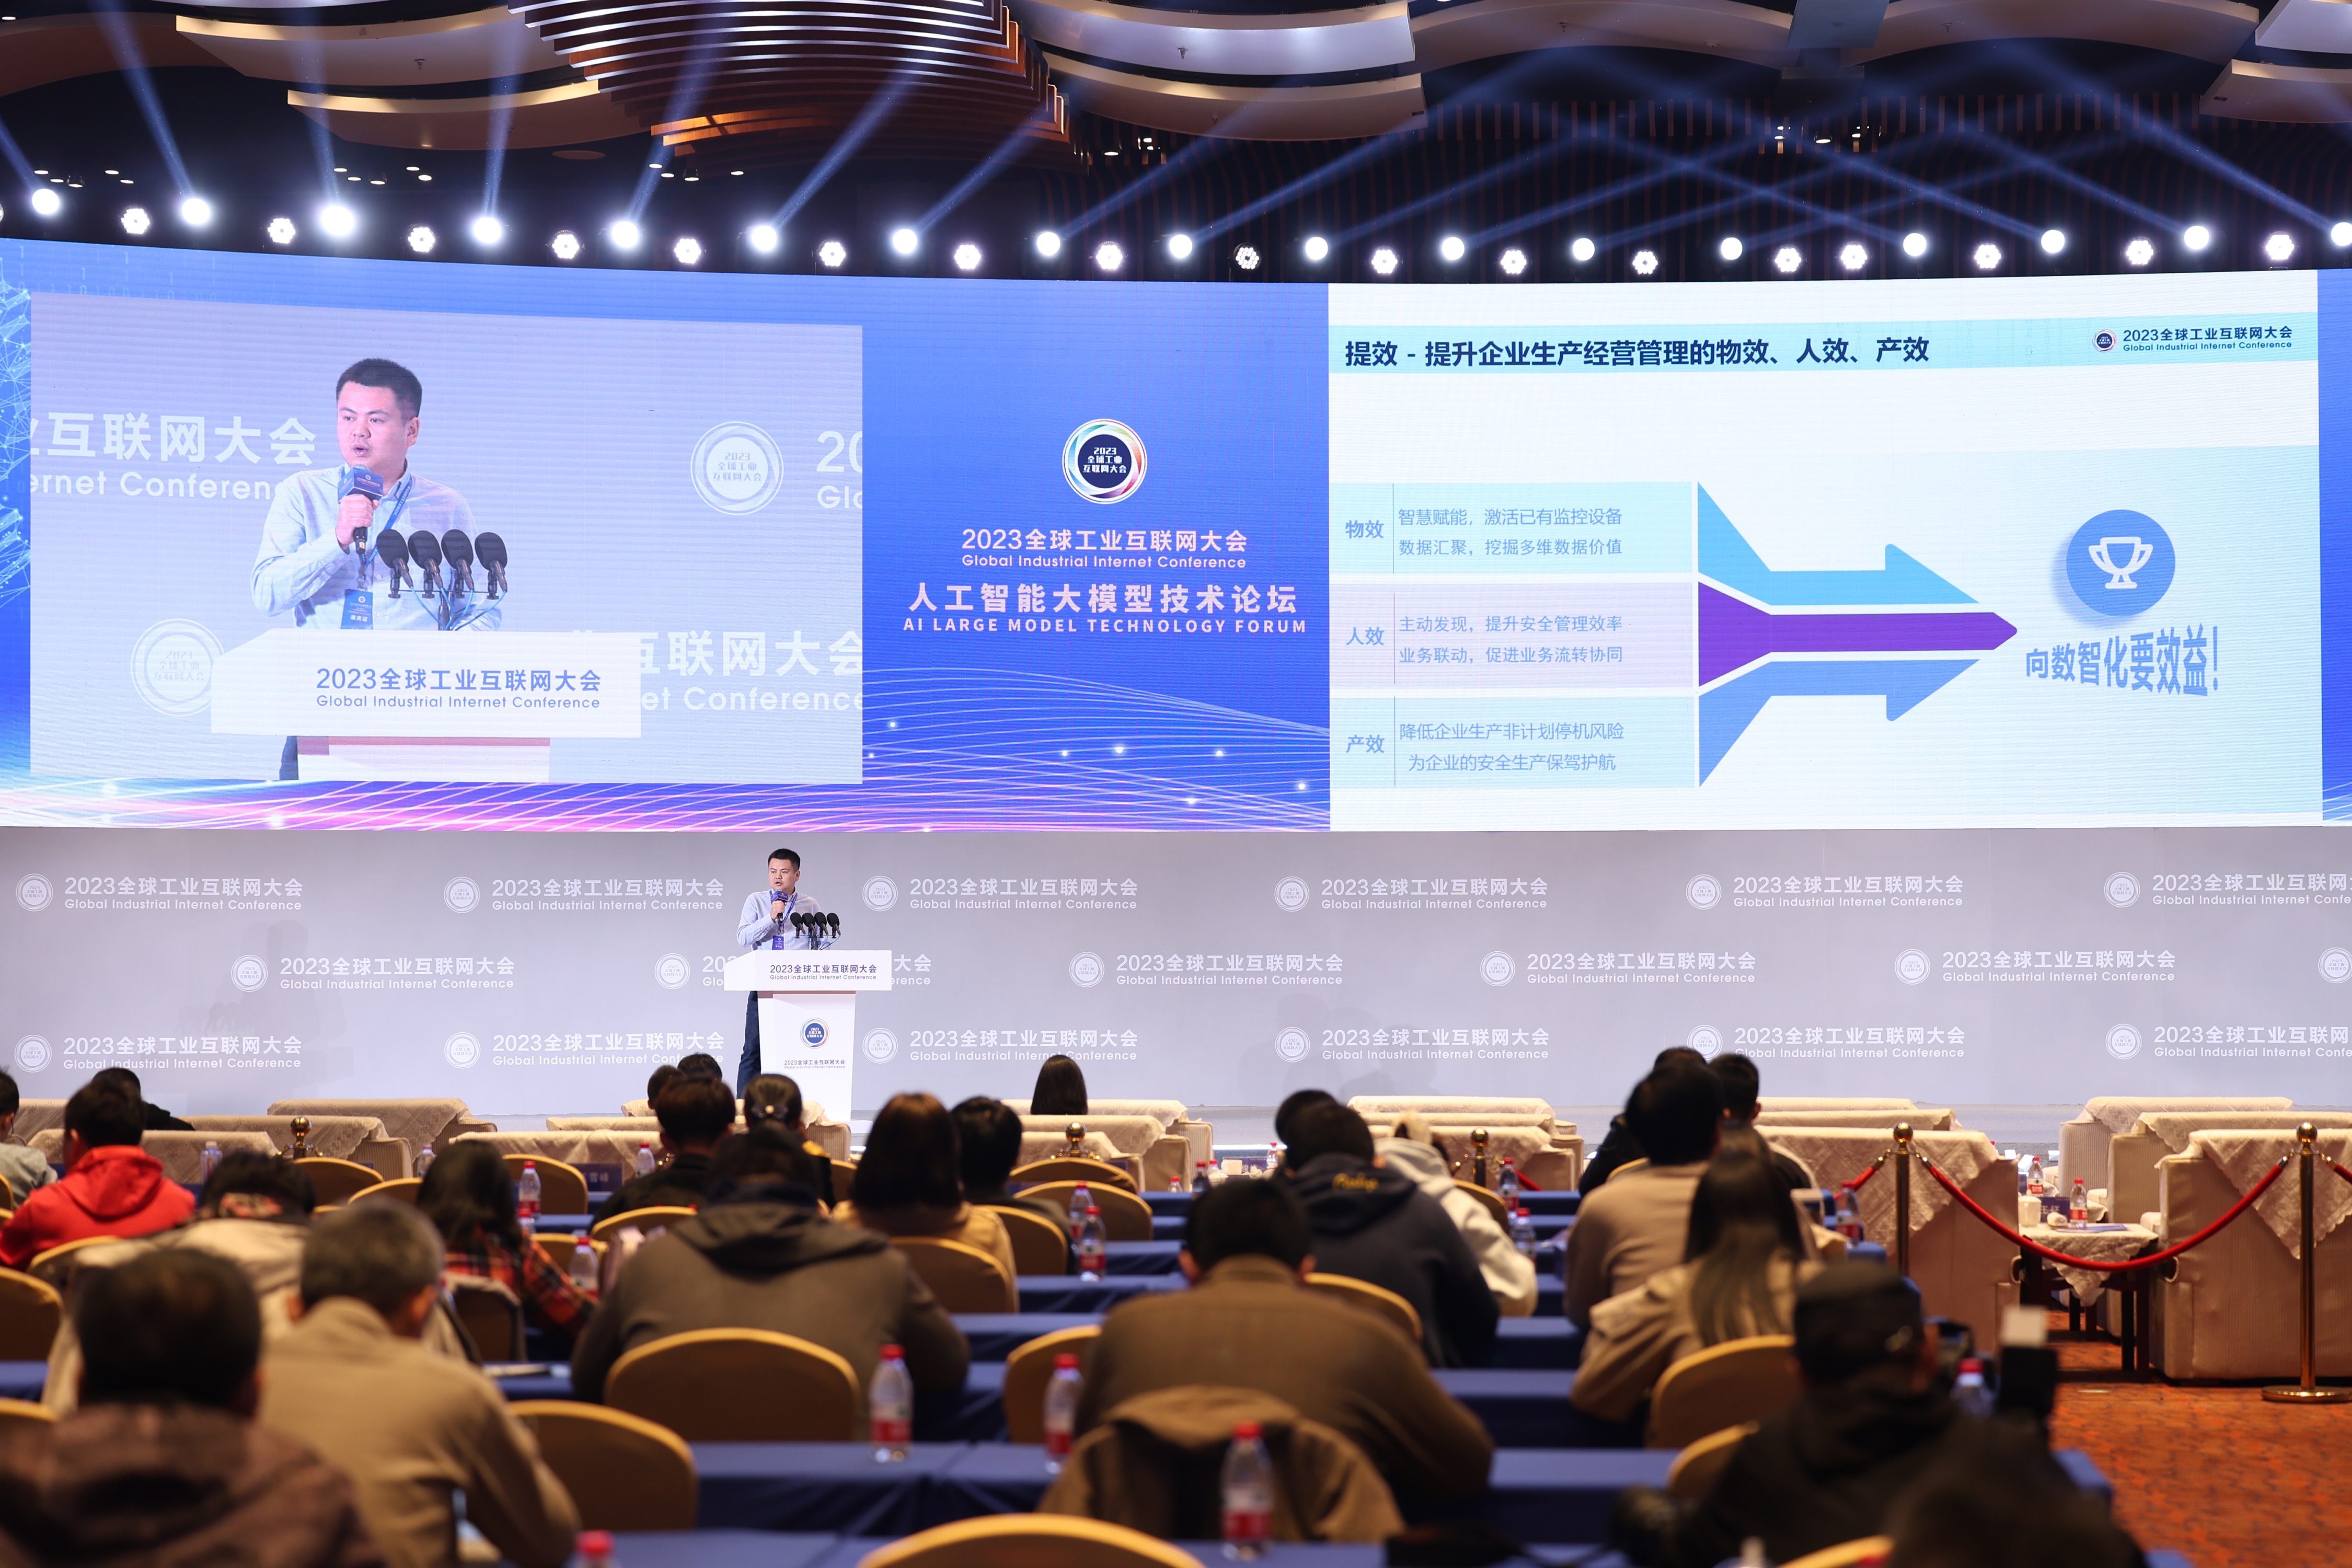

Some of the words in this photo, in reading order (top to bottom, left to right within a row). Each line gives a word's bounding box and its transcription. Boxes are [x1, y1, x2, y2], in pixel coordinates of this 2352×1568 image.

[2123, 326, 2292, 341] 2023全球工业互联网大会
[1345, 341, 1398, 366] 提效
[1425, 336, 1929, 367] 提升企业生产经营管理的物效、人效、产效
[31, 412, 316, 466] 互联网大会
[724, 452, 751, 461] 2023
[1088, 455, 1122, 464] 全球工业
[718, 462, 757, 471] 全球工业
[1083, 464, 1126, 473] 互联网大会
[713, 472, 762, 481] 互联网大会
[1398, 508, 1622, 526] 智慧赋能，激活已有监控设备
[1345, 520, 1384, 539] 物效
[962, 528, 1247, 552] 2023全球工业互联网大会
[1399, 538, 1622, 556] 数据汇聚，挖掘多维数据价值
[962, 554, 1012, 567] Global
[1019, 555, 1088, 567] Industrial
[1094, 556, 1152, 568] Internet
[1157, 556, 1246, 568] Conference
[908, 582, 1296, 614] 人工智能大模型技术论坛
[903, 618, 922, 631] AI
[933, 618, 997, 631] LARGE
[1008, 618, 1077, 632] MODEL
[1087, 619, 1225, 633] TECHNOLOGY
[1236, 620, 1305, 633] FORUM
[1399, 615, 1623, 633] 主动发现，提升安全管理效率
[1346, 627, 1385, 646] 人效
[1399, 646, 1622, 664] 业务联动，促进业务流转协同
[317, 668, 601, 691] 2023全球工业互联网大会
[316, 695, 367, 707] Global
[374, 696, 442, 708] Industrial
[449, 696, 506, 708] Internet
[512, 696, 600, 708] Conference
[1400, 722, 1624, 741] 降低企业生产非计划停机风险
[1346, 734, 1385, 754] 产效
[1409, 753, 1616, 771] 为企业的安全生产保驾护航
[65, 877, 303, 897] 2023全球工业互联网大会
[492, 878, 723, 897] 2023全球工业互联网大会
[909, 878, 1137, 896] 2023全球工业互联网大会
[1321, 878, 1548, 896] 2023全球工业互联网大会
[1733, 875, 1963, 894] 2023全球工业互联网大会
[2152, 873, 2352, 892] 2023全球工业互联网
[65, 898, 107, 909] Global
[112, 899, 170, 909] Industrial
[175, 900, 224, 909] Internet
[228, 900, 302, 910] Conference
[492, 901, 534, 910] Global
[538, 901, 595, 910] Industrial
[599, 900, 647, 910] Internet
[651, 900, 723, 910] Conference
[910, 899, 950, 909] Global
[955, 900, 1010, 909] Industrial
[1015, 899, 1062, 909] Internet
[1066, 899, 1137, 909] Conference
[1321, 900, 1362, 909] Global
[1366, 900, 1421, 909] Industrial
[1426, 899, 1472, 909] Internet
[1476, 899, 1547, 908] Conference
[1734, 897, 1774, 907] Global
[1779, 897, 1835, 907] Industrial
[1839, 897, 1886, 906] Internet
[1890, 896, 1963, 906] Conference
[2152, 895, 2194, 905] Global
[2199, 895, 2256, 905] Industrial
[2261, 895, 2310, 904] Internet
[280, 956, 515, 976] 2023全球工业互联网大会
[894, 954, 932, 972] 大会
[1116, 953, 1343, 972] 2023全球工业互联网大会
[1527, 952, 1756, 970] 2023全球工业互联网大会
[1942, 950, 2175, 969] 2023全球工业互联网大会
[770, 964, 877, 974] 2023全球工业互联网大会
[1943, 972, 1984, 982] Global
[1988, 972, 2045, 982] Industrial
[2049, 972, 2097, 981] Internet
[2102, 971, 2175, 981] Conference
[280, 979, 322, 989] Global
[327, 979, 384, 989] Industrial
[389, 979, 437, 989] Internet
[441, 978, 514, 988] Conference
[702, 977, 723, 986] Glo
[1116, 975, 1157, 985] Global
[1161, 975, 1216, 985] Industrial
[1221, 975, 1267, 985] Internet
[1272, 975, 1342, 985] Conference
[1527, 974, 1567, 984] Global
[1572, 973, 1628, 983] Industrial
[1632, 973, 1679, 983] Internet
[1684, 973, 1755, 983] Conference
[492, 1031, 724, 1052] 2023全球工业互联网大会
[909, 1029, 1138, 1047] 2023全球工业互联网大会
[1322, 1028, 1549, 1046] 2023全球工业互联网大会
[1734, 1026, 1965, 1045] 2023全球工业互联网大会
[2154, 1025, 2352, 1044] 2023全球工业互联网
[63, 1035, 302, 1055] 2023全球工业互联网大会
[1735, 1048, 1775, 1057] Global
[1780, 1048, 1836, 1058] Industrial
[1841, 1048, 1888, 1057] Internet
[1892, 1047, 1964, 1057] Conference
[2154, 1047, 2196, 1057] Global
[2200, 1047, 2257, 1057] Industrial
[2263, 1047, 2311, 1057] Internet
[63, 1059, 106, 1069] Global
[110, 1059, 169, 1068] Industrial
[174, 1058, 223, 1068] Internet
[227, 1058, 301, 1068] Conference
[493, 1055, 534, 1066] Global
[539, 1055, 595, 1065] Industrial
[600, 1054, 648, 1064] Internet
[910, 1051, 950, 1060] Global
[955, 1051, 1010, 1060] Industrial
[1066, 1051, 1137, 1060] Conference
[1322, 1050, 1363, 1060] Global
[1367, 1050, 1422, 1059] Industrial
[1427, 1049, 1473, 1059] Internet
[1477, 1049, 1549, 1059] Conference
